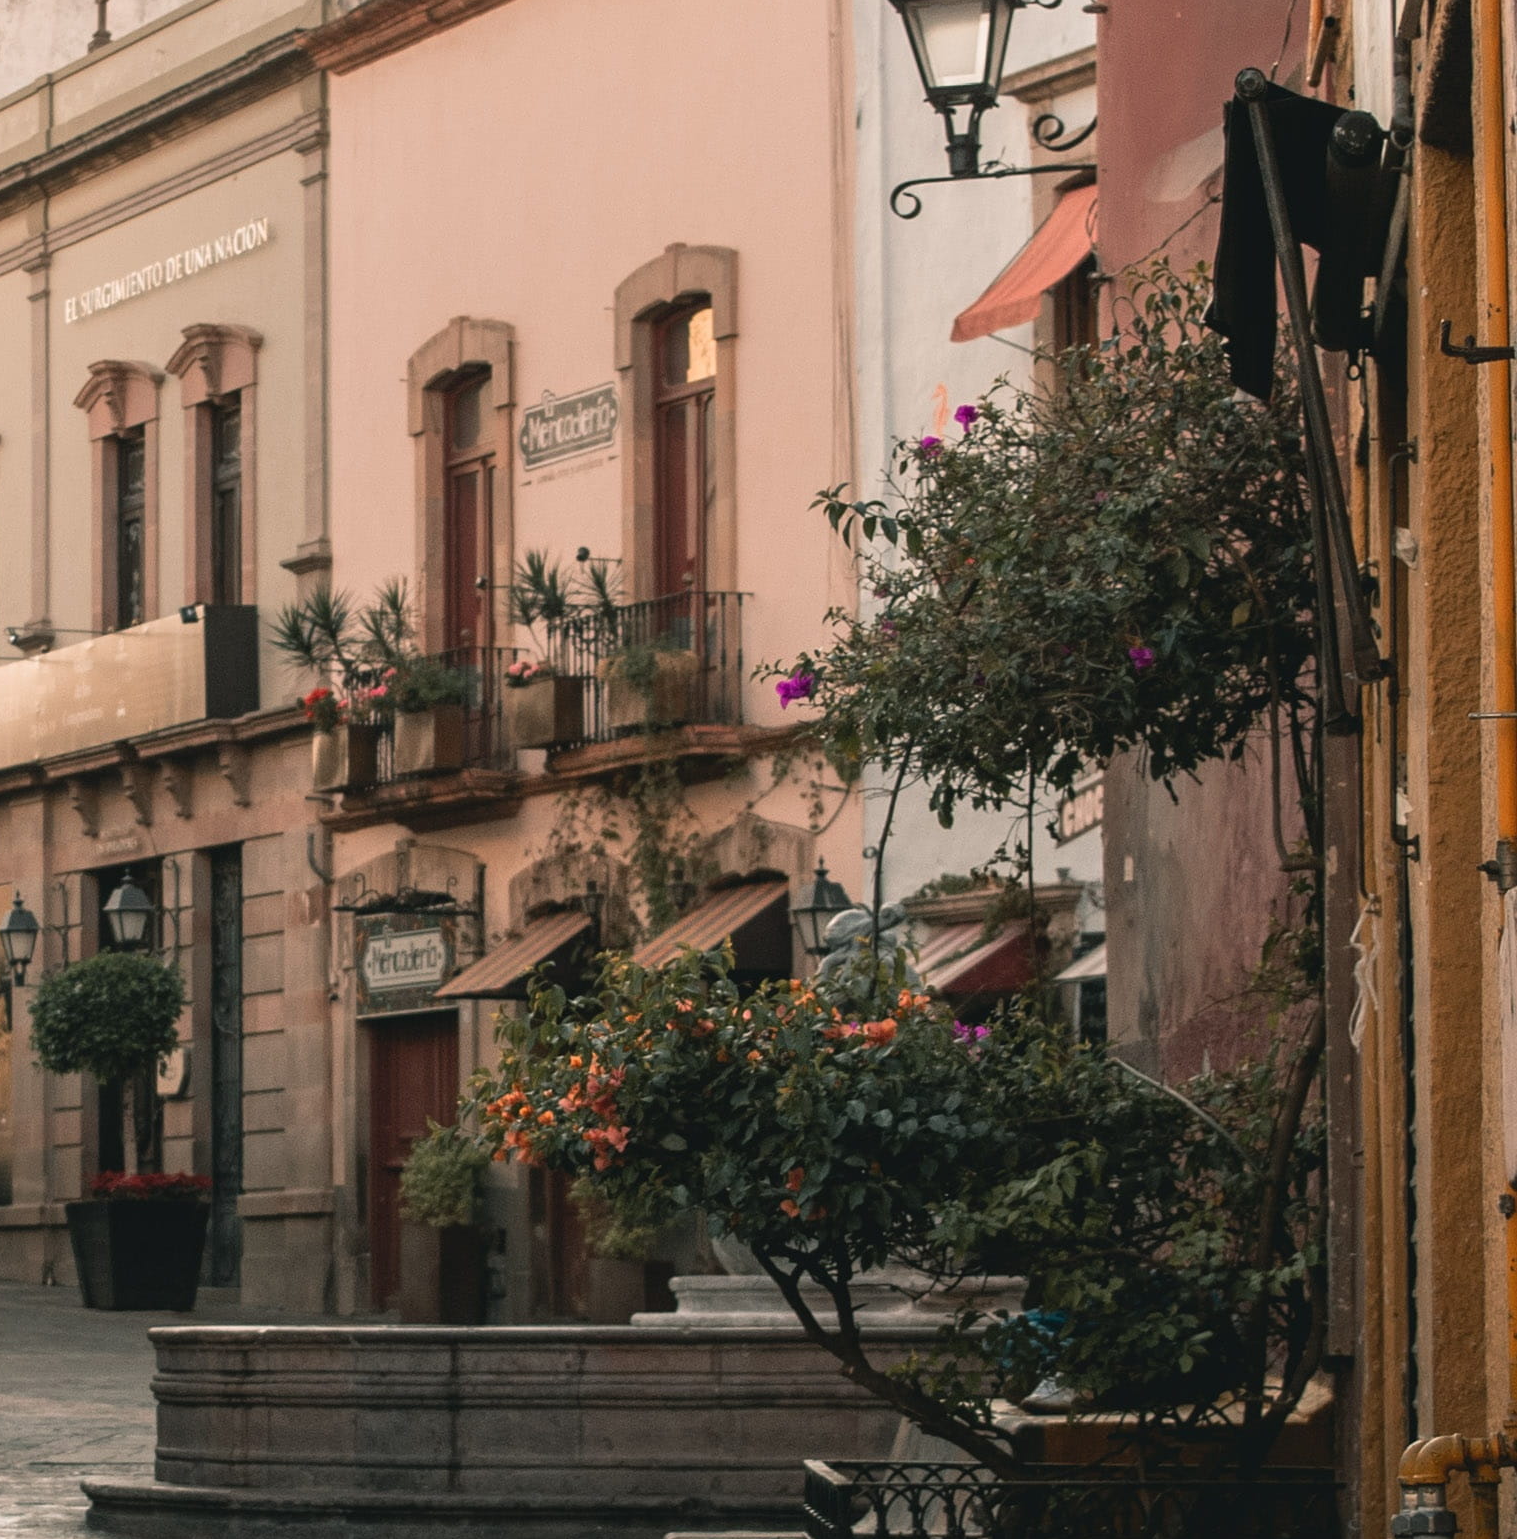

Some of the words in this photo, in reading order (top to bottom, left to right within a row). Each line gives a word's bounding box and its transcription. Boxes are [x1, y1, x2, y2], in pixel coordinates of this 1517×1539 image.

[65, 297, 78, 324] EL
[79, 261, 163, 317] SURGIMIENTO
[164, 253, 183, 284] DE
[183, 241, 212, 276] UNA
[528, 396, 610, 452] Mercadería
